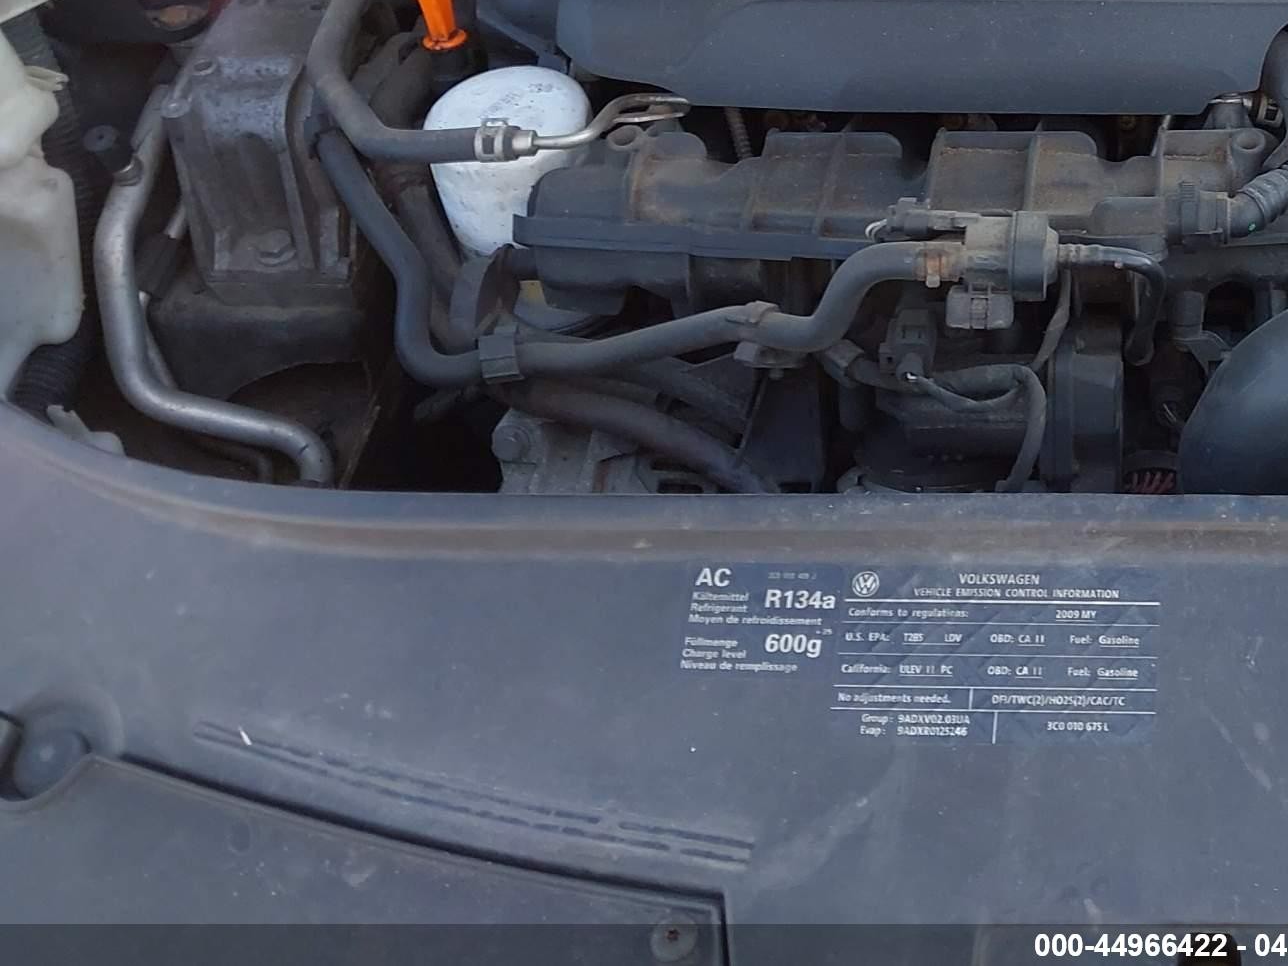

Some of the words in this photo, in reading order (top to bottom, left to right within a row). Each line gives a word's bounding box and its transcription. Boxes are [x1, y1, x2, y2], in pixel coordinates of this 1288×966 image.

[695, 567, 732, 587] AC
[959, 573, 1041, 585] VOLKSWAGEN
[764, 589, 836, 609] R134a
[913, 587, 953, 597] VEHICLE
[955, 588, 1001, 597] EMISSION
[1004, 588, 1049, 598] CONTROL
[1052, 589, 1120, 599] INFORMATION
[690, 603, 748, 614] Refrigerant
[848, 607, 894, 617] Conforms
[897, 608, 909, 617] to
[911, 608, 969, 619] regulations:
[1055, 610, 1079, 619] 2009
[1080, 610, 1097, 619] MY
[688, 614, 723, 625] Moyen
[726, 615, 739, 624] de
[742, 615, 822, 625] refroidissement
[845, 632, 864, 642] U.S.
[868, 632, 890, 642] EPA:
[944, 633, 963, 643] LDV
[990, 634, 1014, 643] OBD:
[1018, 634, 1031, 644] CA
[1069, 635, 1093, 644] Fuel:
[1098, 635, 1140, 645] Gasoline
[764, 634, 823, 658] 600g
[682, 649, 719, 659] Charge
[721, 649, 747, 659] level
[680, 660, 716, 670] Niveau
[719, 661, 732, 670] de
[735, 662, 798, 673] remplissage
[841, 663, 892, 674] California:
[940, 665, 953, 675] PC
[987, 666, 1011, 676] OBD:
[1015, 666, 1029, 676] CA
[1067, 666, 1091, 677] Fuel:
[1096, 667, 1139, 677] Gasoline
[837, 692, 852, 702] No
[853, 693, 912, 704] adjustments
[913, 694, 952, 704] needed.
